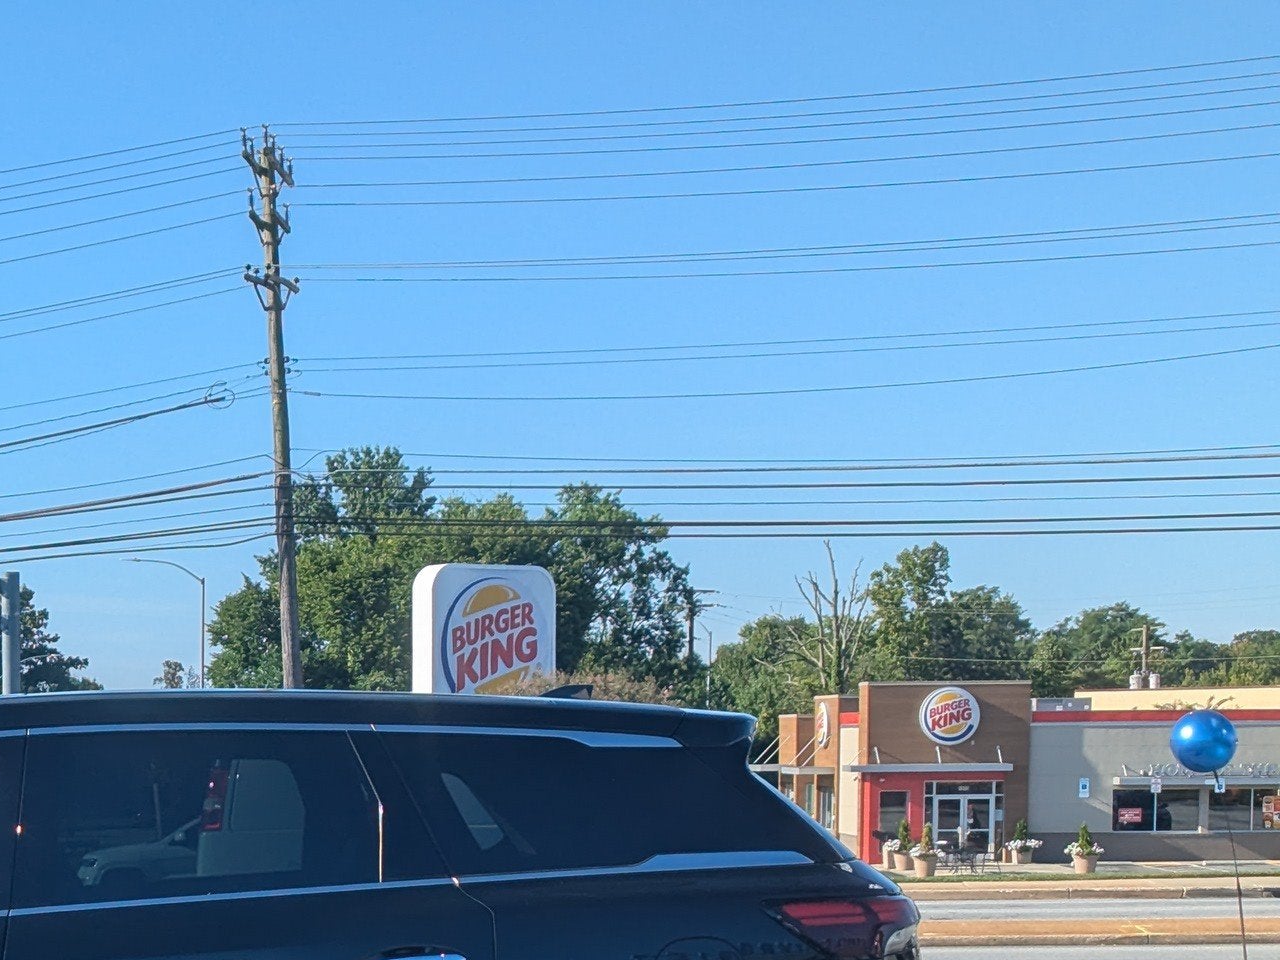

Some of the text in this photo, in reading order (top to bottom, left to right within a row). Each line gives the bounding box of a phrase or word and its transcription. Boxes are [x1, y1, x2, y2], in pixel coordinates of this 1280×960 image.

[451, 602, 535, 655] BURGER
[456, 627, 538, 694] KING
[929, 698, 971, 719] BURGER
[931, 707, 973, 732] KING
